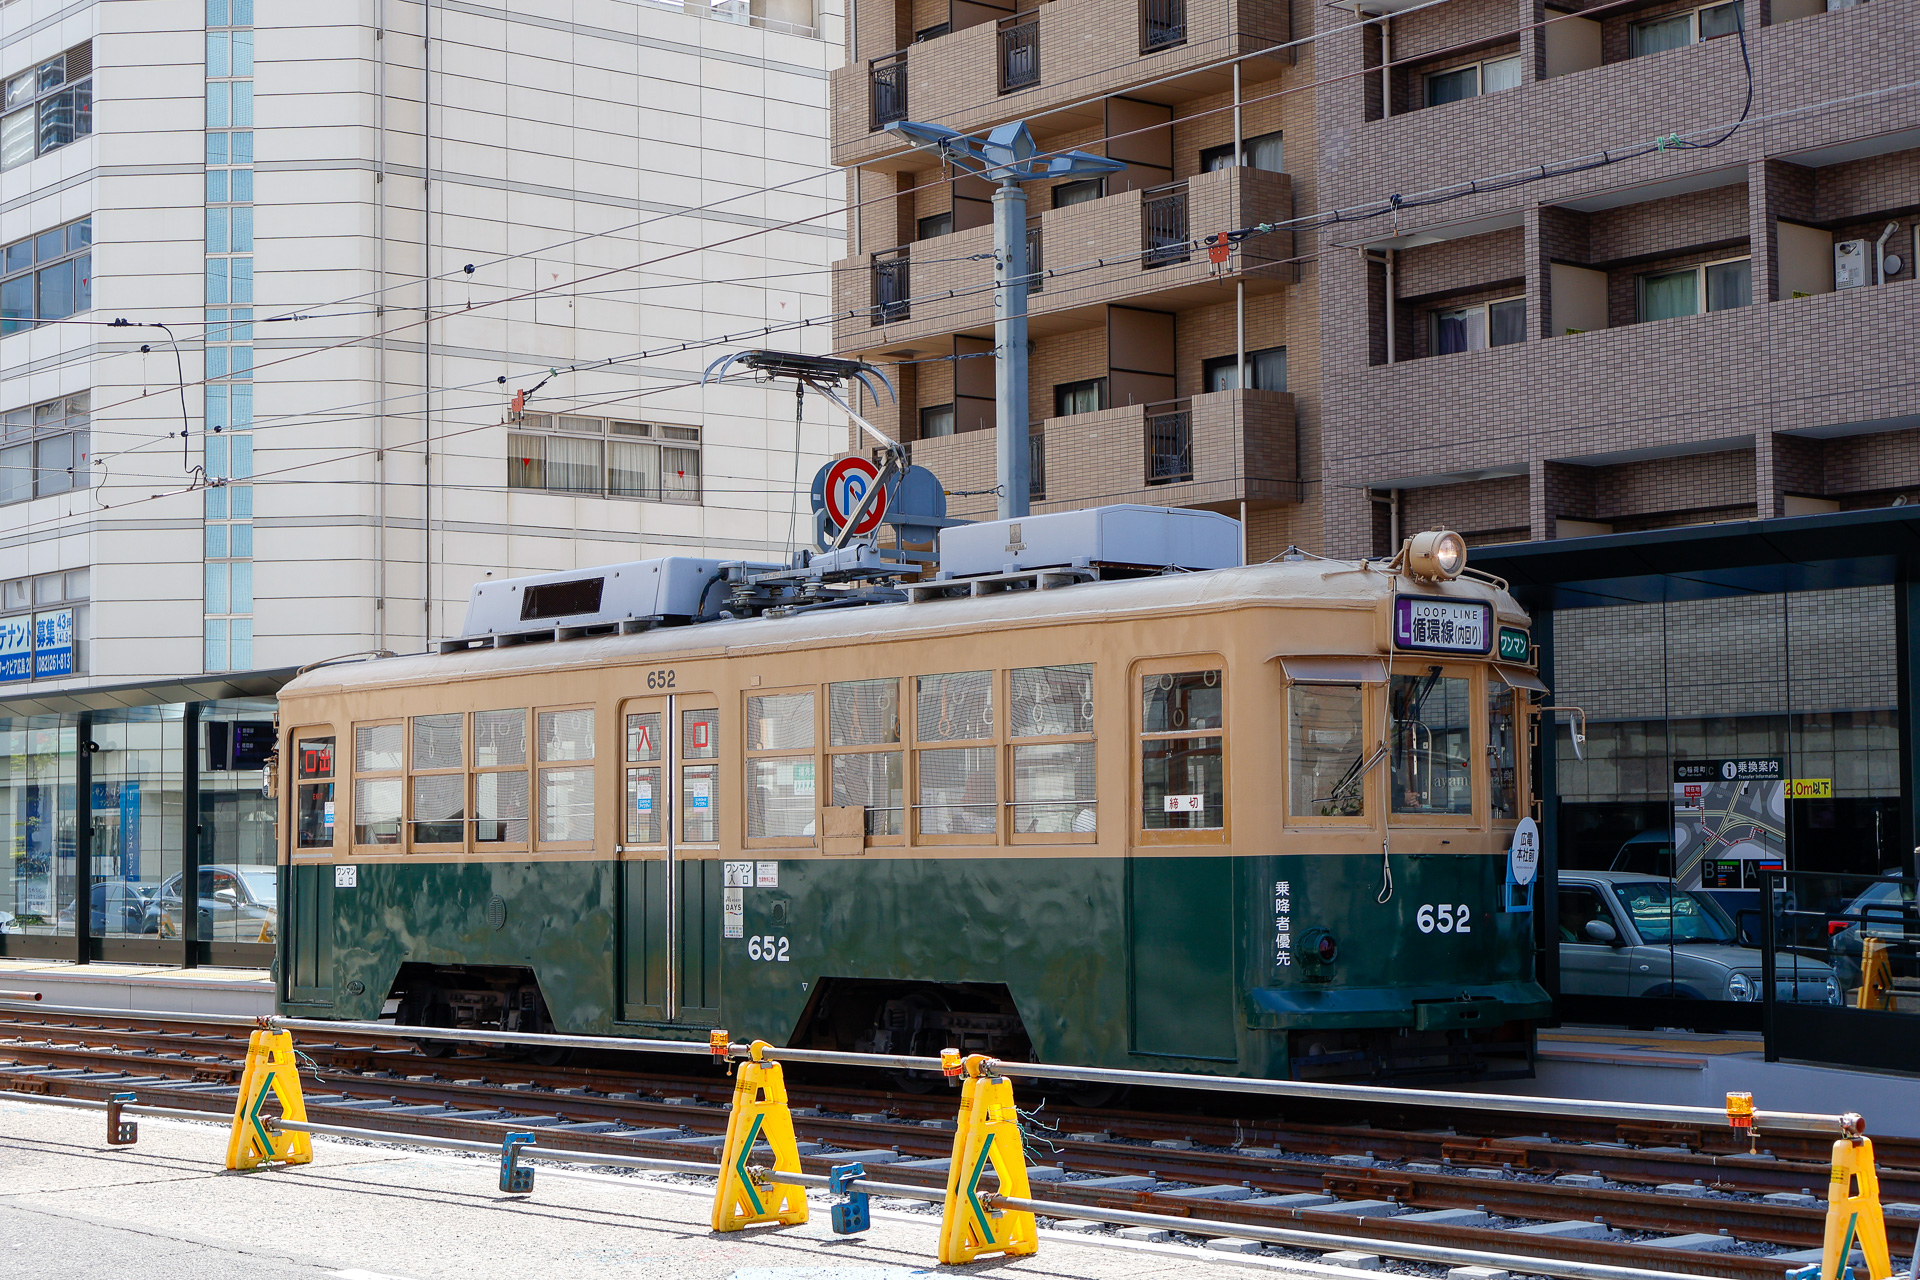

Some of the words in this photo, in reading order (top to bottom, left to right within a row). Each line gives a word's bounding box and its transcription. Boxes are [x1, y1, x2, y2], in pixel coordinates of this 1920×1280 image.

[1416, 607, 1447, 618] LOOP
[1453, 609, 1478, 620] LINE
[1399, 609, 1410, 638] L
[1412, 617, 1482, 646] 循環線(内回り)
[37, 618, 55, 648] 募集
[1500, 636, 1527, 654] ワンマン
[37, 652, 72, 673] (082)261-813
[647, 669, 676, 689] 652
[1737, 760, 1779, 773] 乗換案内
[1784, 781, 1829, 795] 2.0m以下
[1169, 797, 1199, 809] 締切
[336, 867, 356, 876] ワンマン
[726, 863, 752, 873] ワンマン
[1704, 861, 1714, 878] B
[1745, 861, 1757, 878] A
[1275, 880, 1291, 967] 乗降者優先
[1416, 903, 1471, 933] 652
[748, 935, 790, 962] 652
